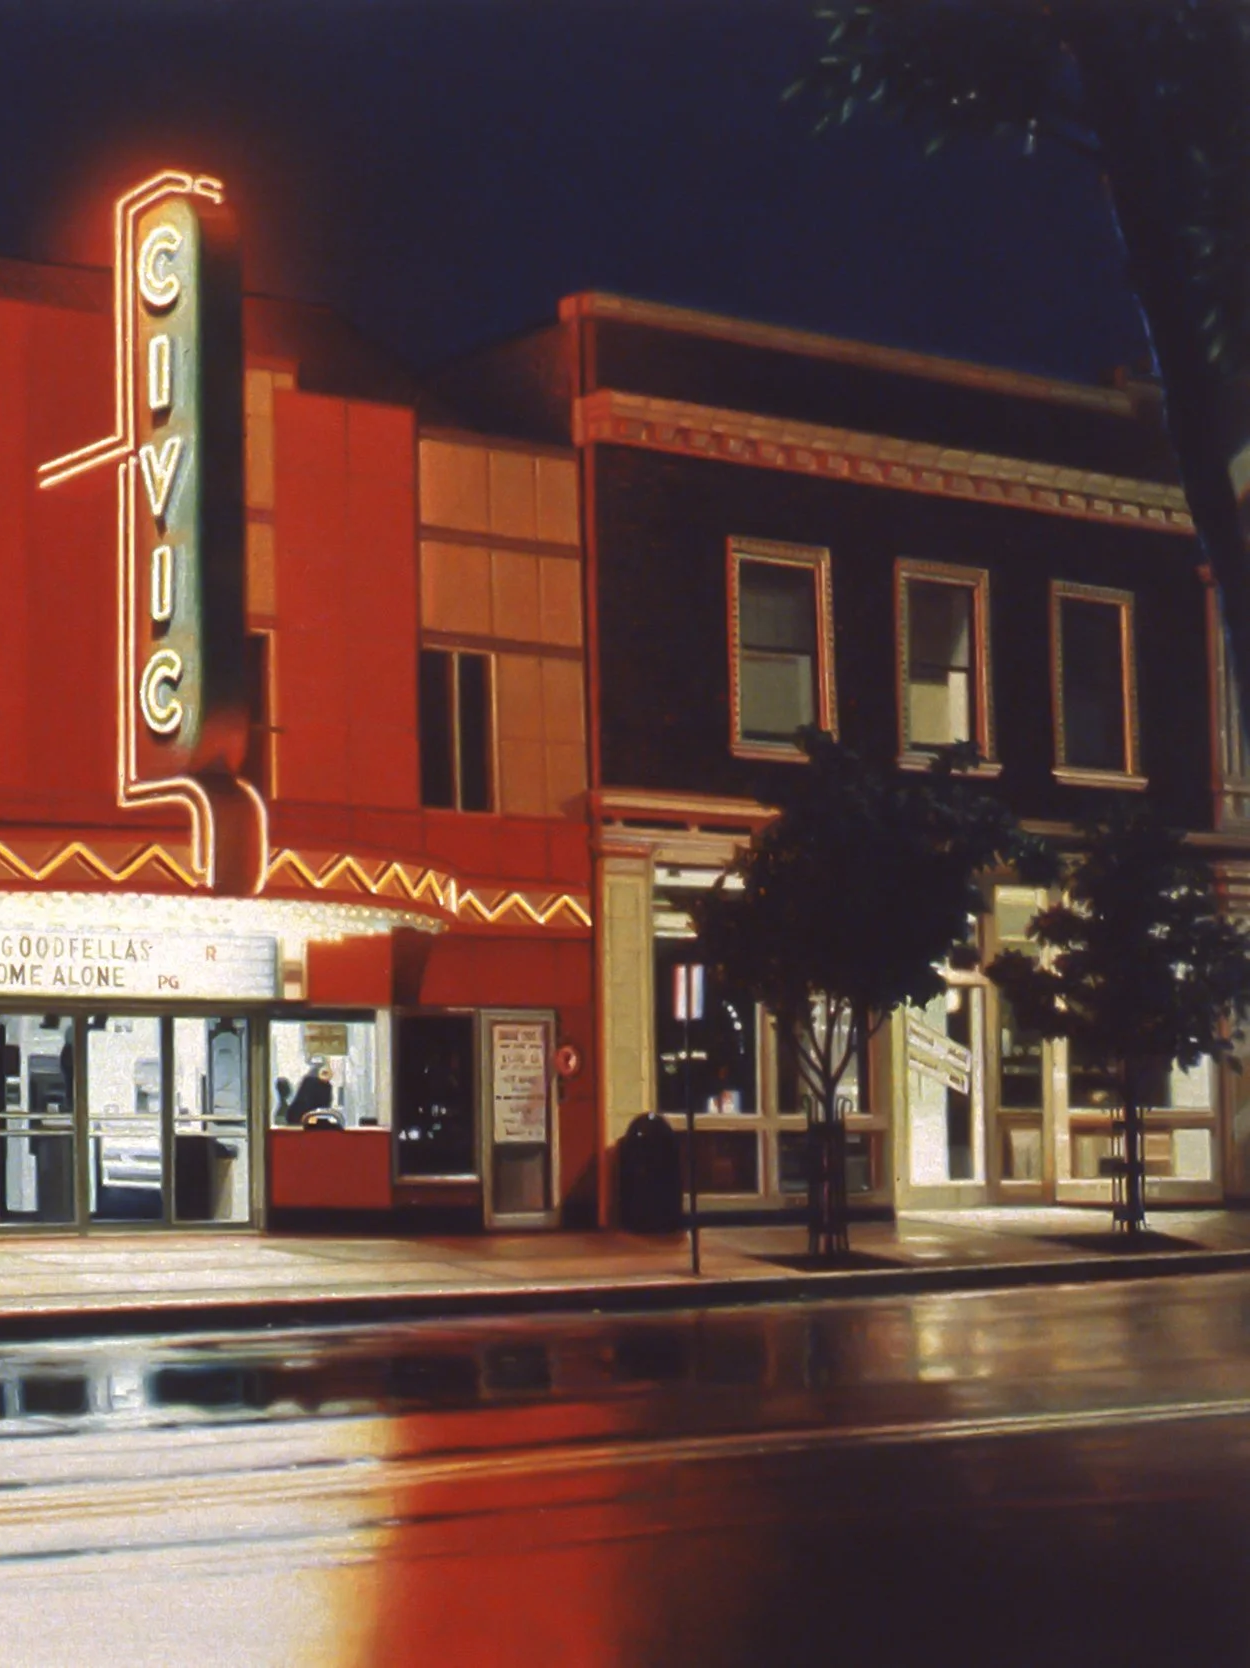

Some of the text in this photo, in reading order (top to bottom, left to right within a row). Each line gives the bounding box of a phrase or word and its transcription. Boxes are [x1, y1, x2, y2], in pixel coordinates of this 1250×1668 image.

[138, 225, 182, 734] CIVIC
[1, 936, 218, 962] GOODFELLAS R
[52, 965, 126, 987] ALONE
[158, 975, 180, 989] PG
